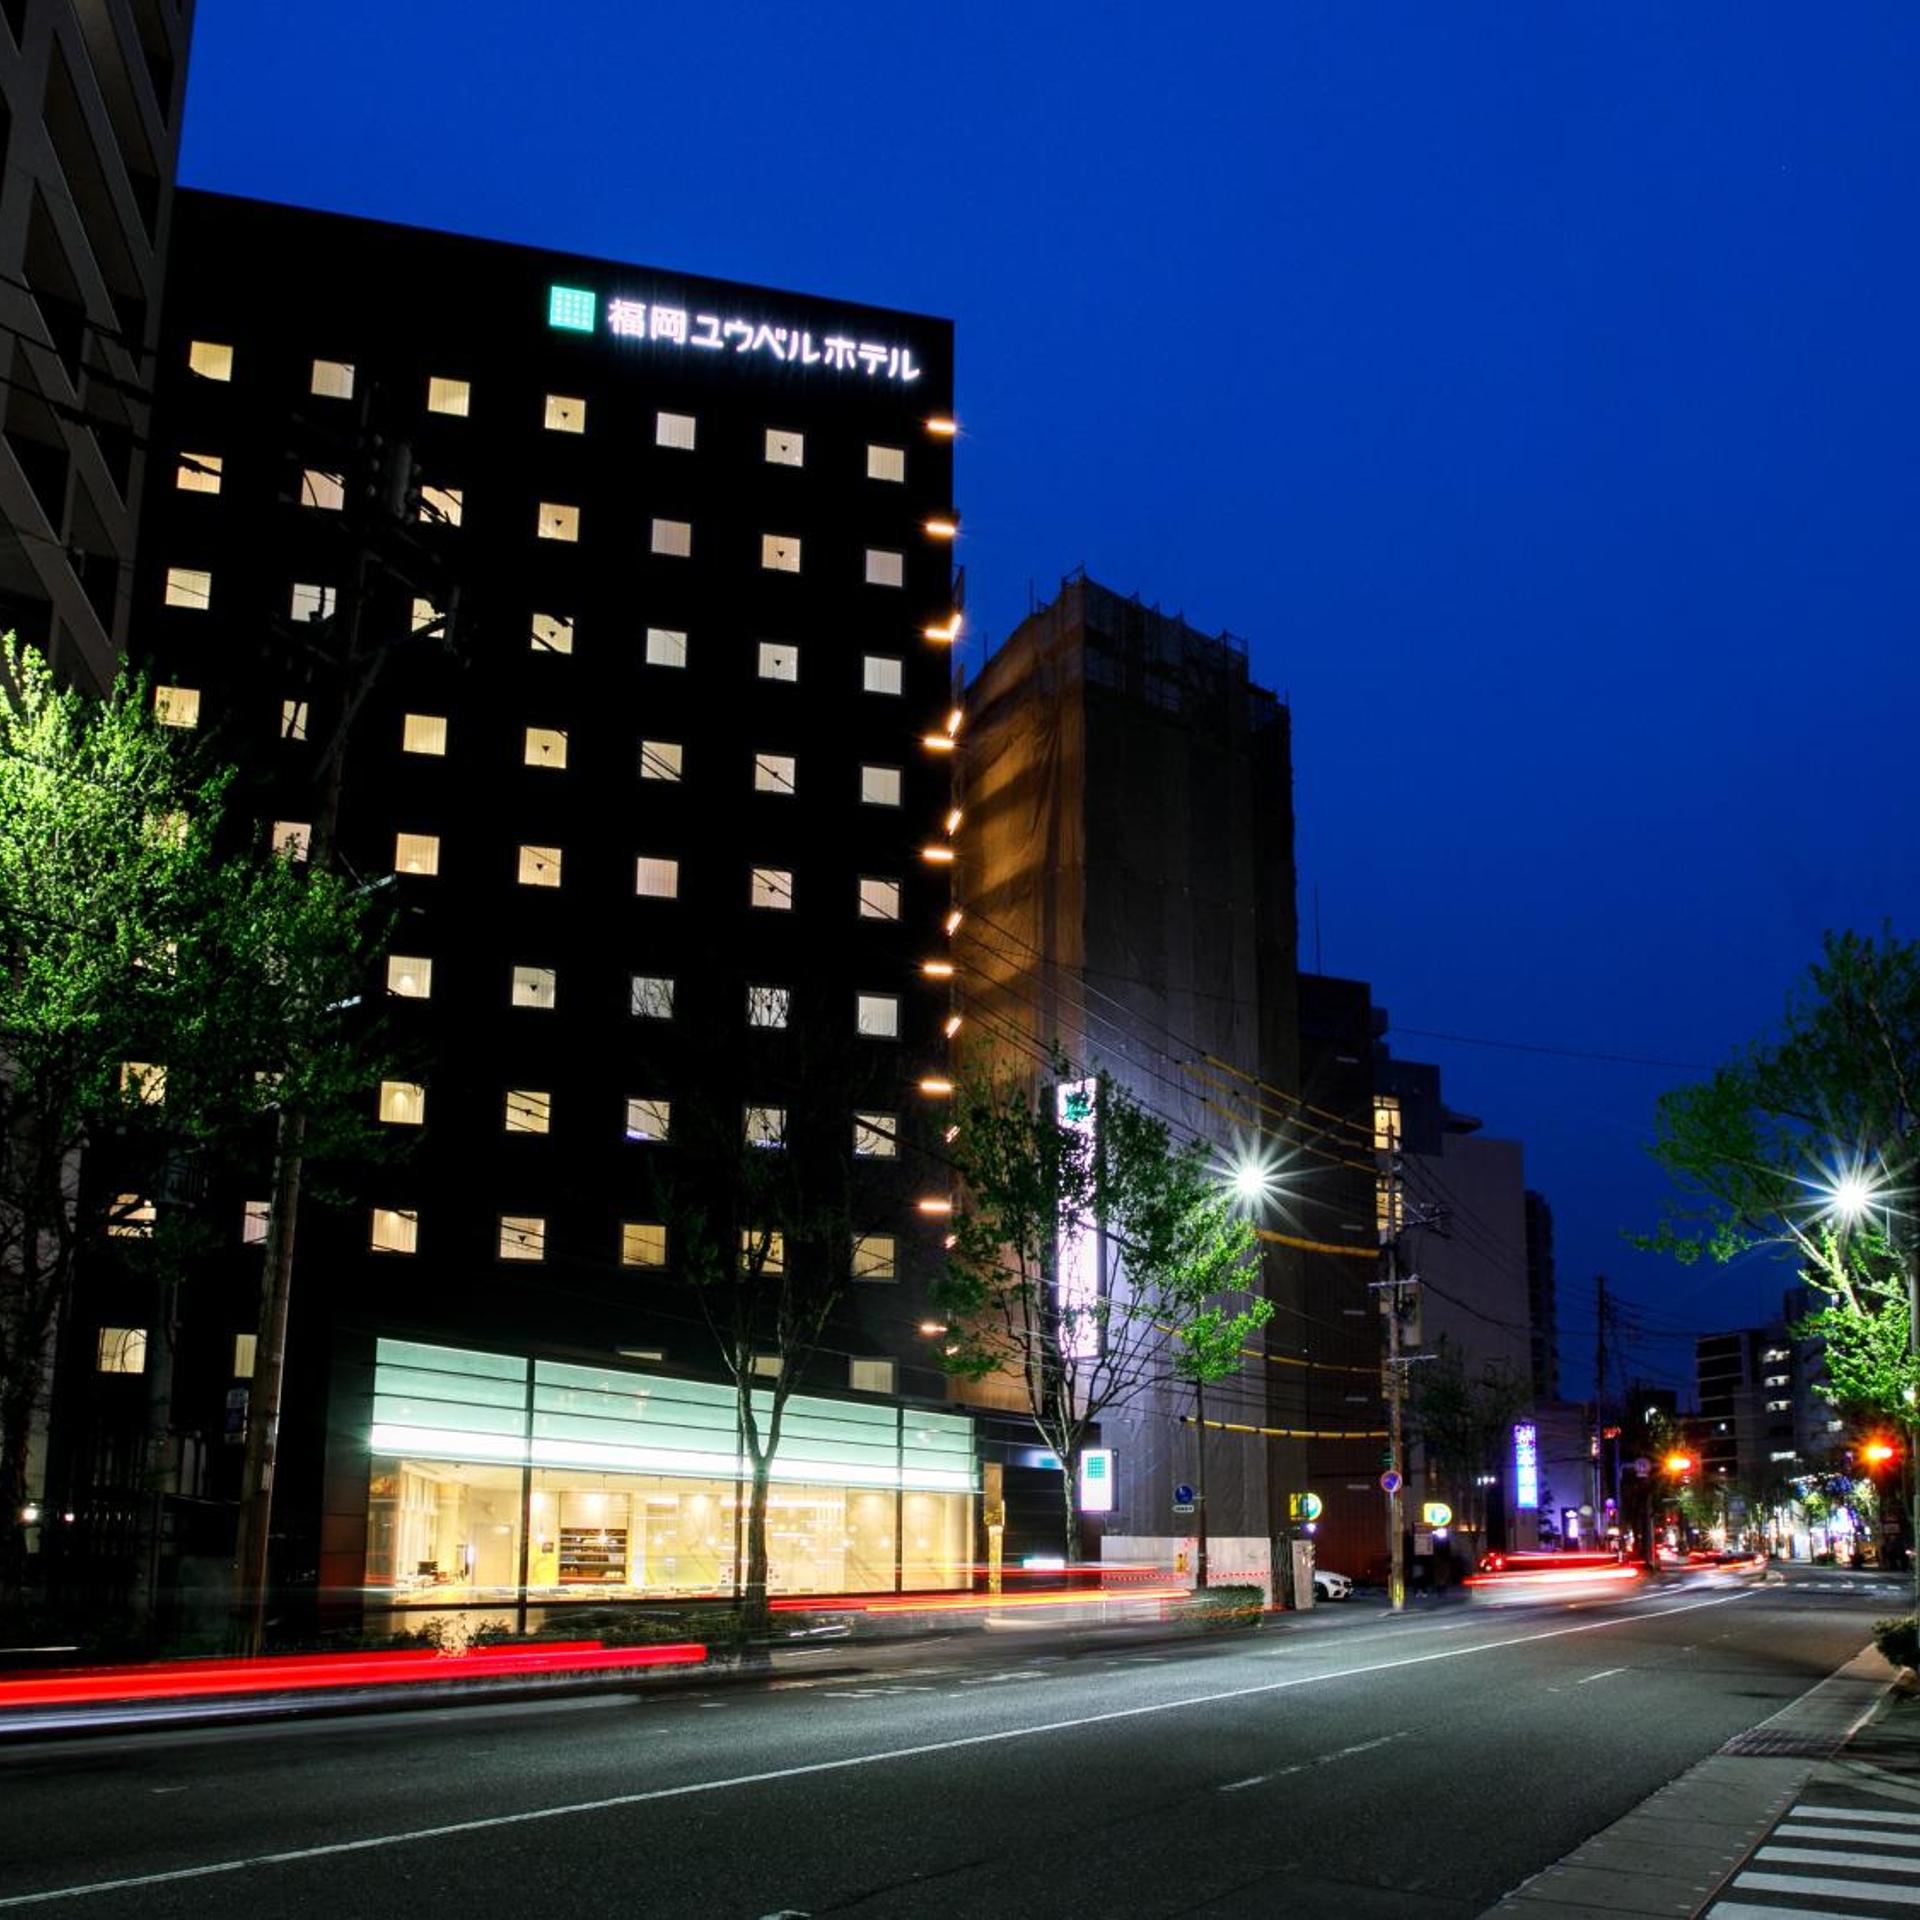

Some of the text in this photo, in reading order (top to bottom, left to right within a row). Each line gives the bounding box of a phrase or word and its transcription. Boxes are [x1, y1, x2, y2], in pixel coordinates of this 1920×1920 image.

[607, 299, 920, 381] 福岡ユウベルホテル
